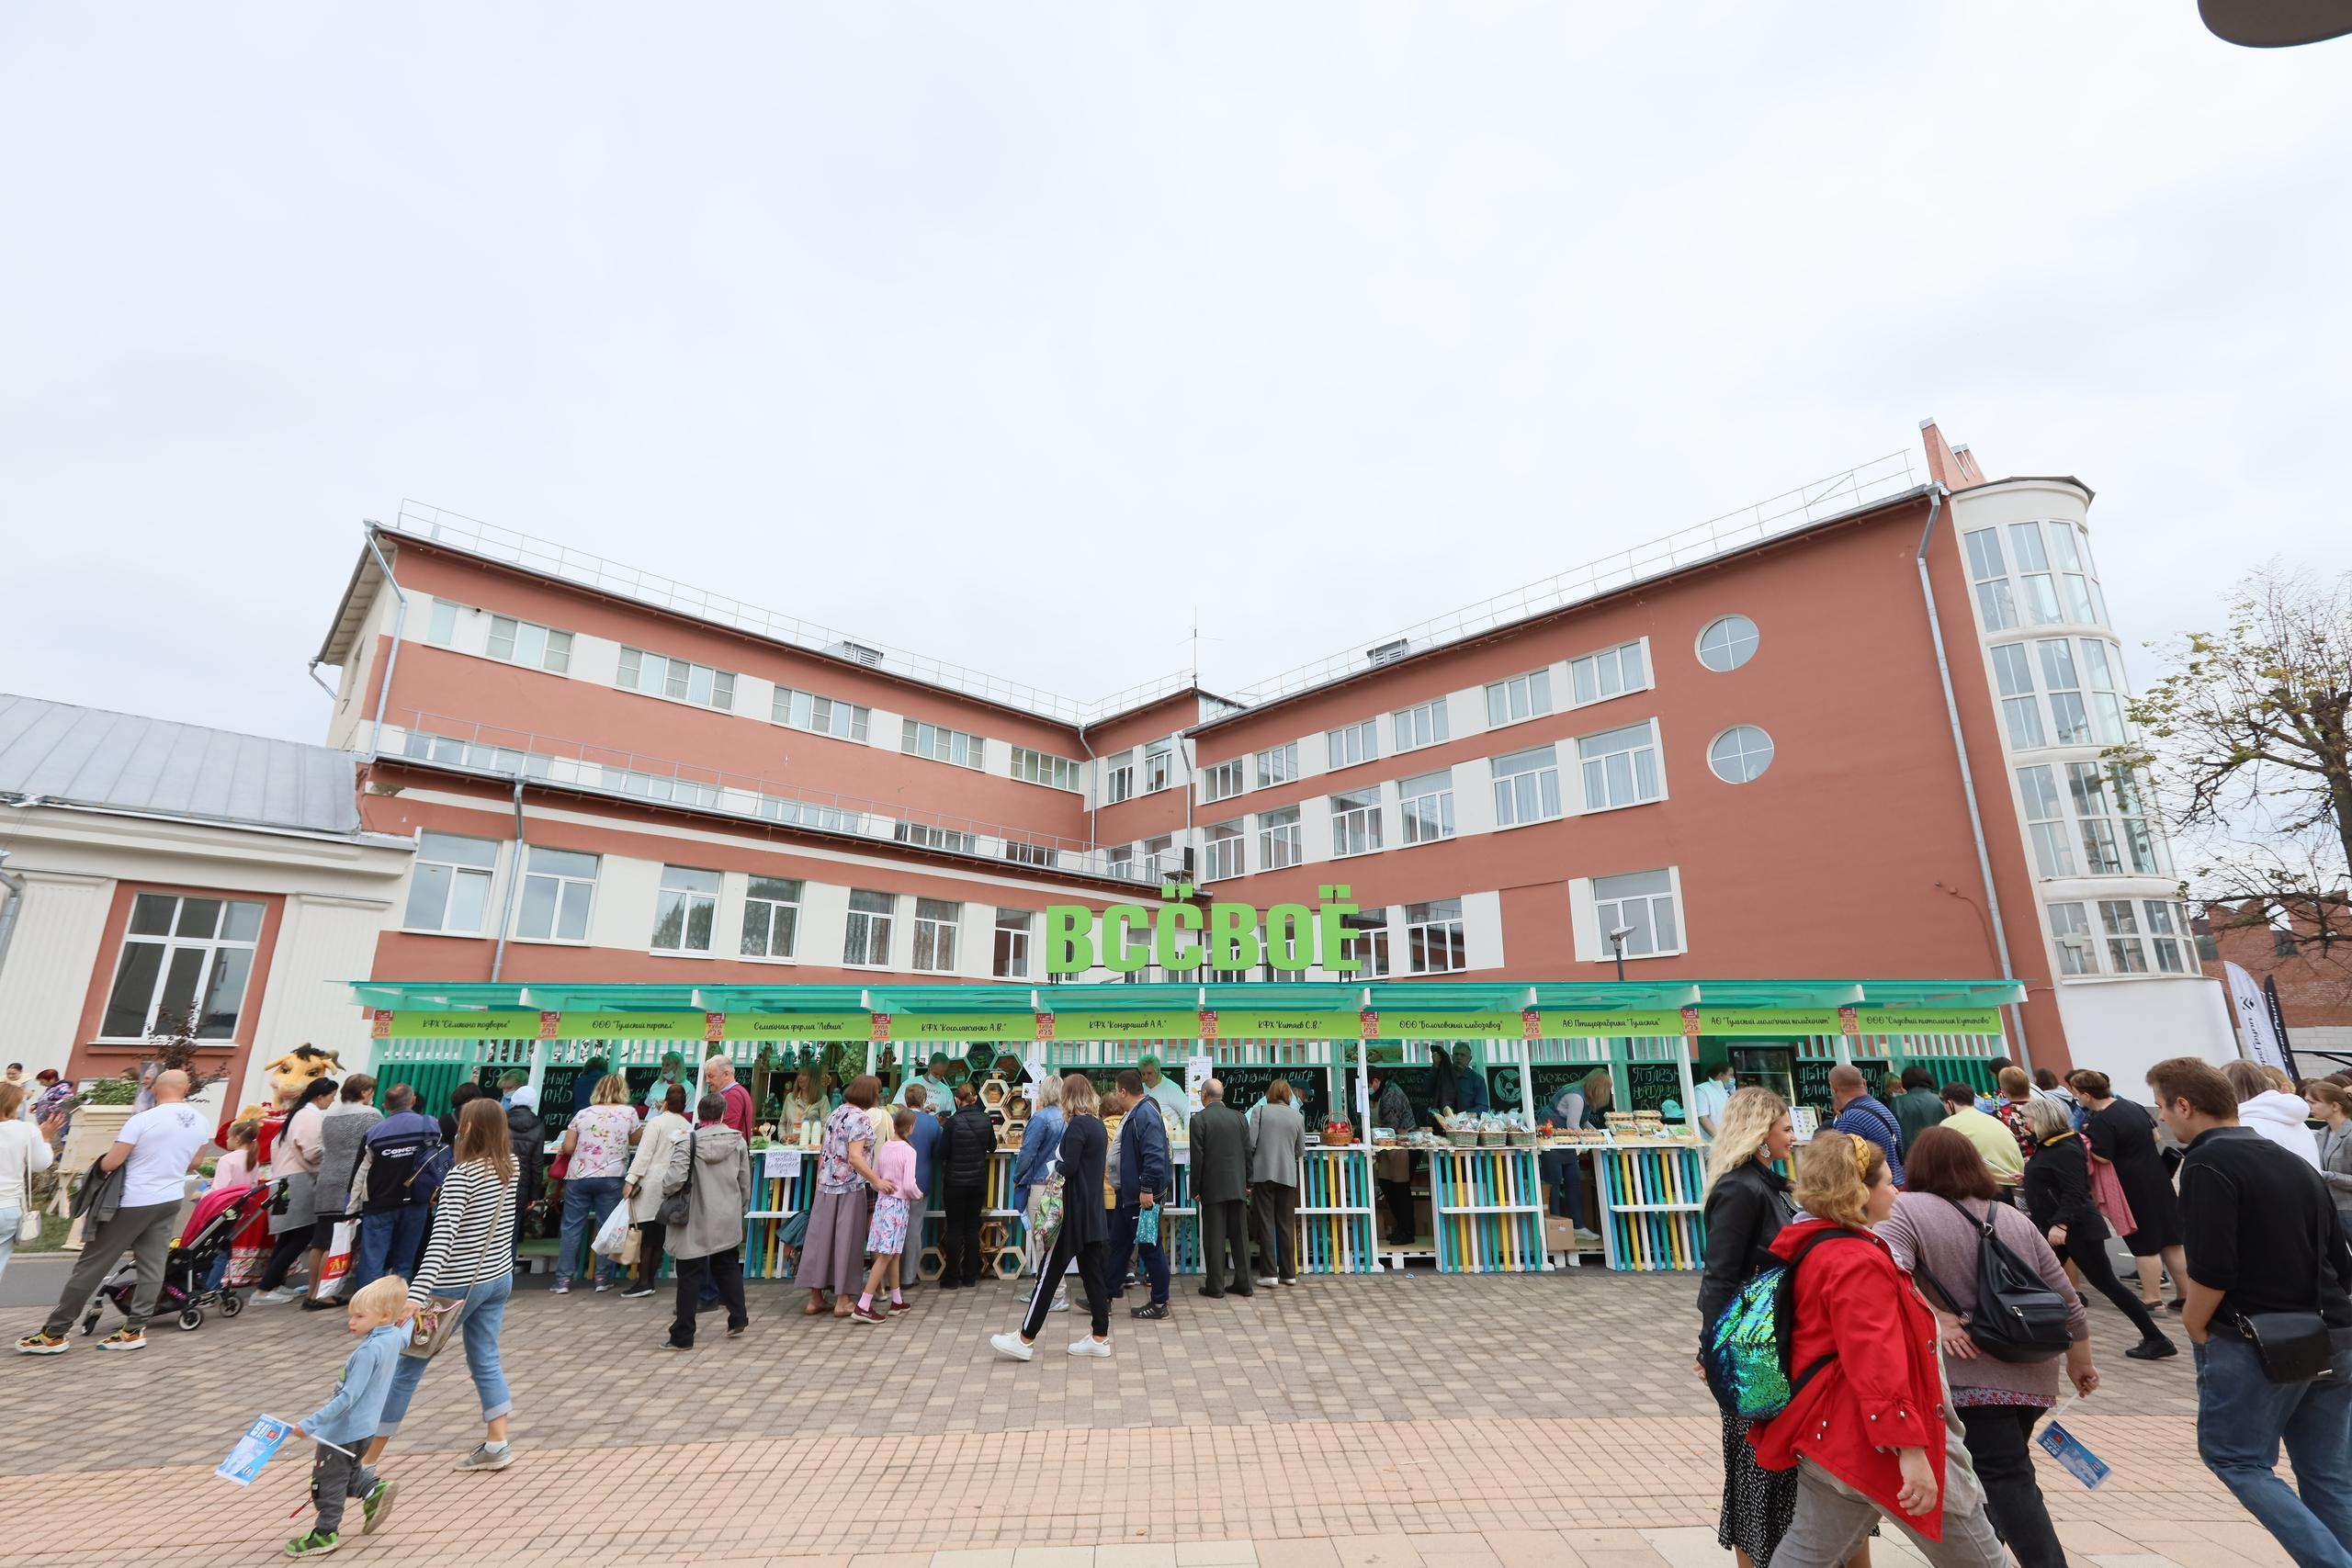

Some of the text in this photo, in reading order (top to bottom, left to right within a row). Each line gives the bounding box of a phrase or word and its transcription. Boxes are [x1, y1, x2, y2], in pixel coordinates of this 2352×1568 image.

[791, 1023, 815, 1032] ферма
[922, 1023, 938, 1032] КФХ
[1089, 1021, 1106, 1029] КФХ
[1258, 1021, 1275, 1029] КФХ
